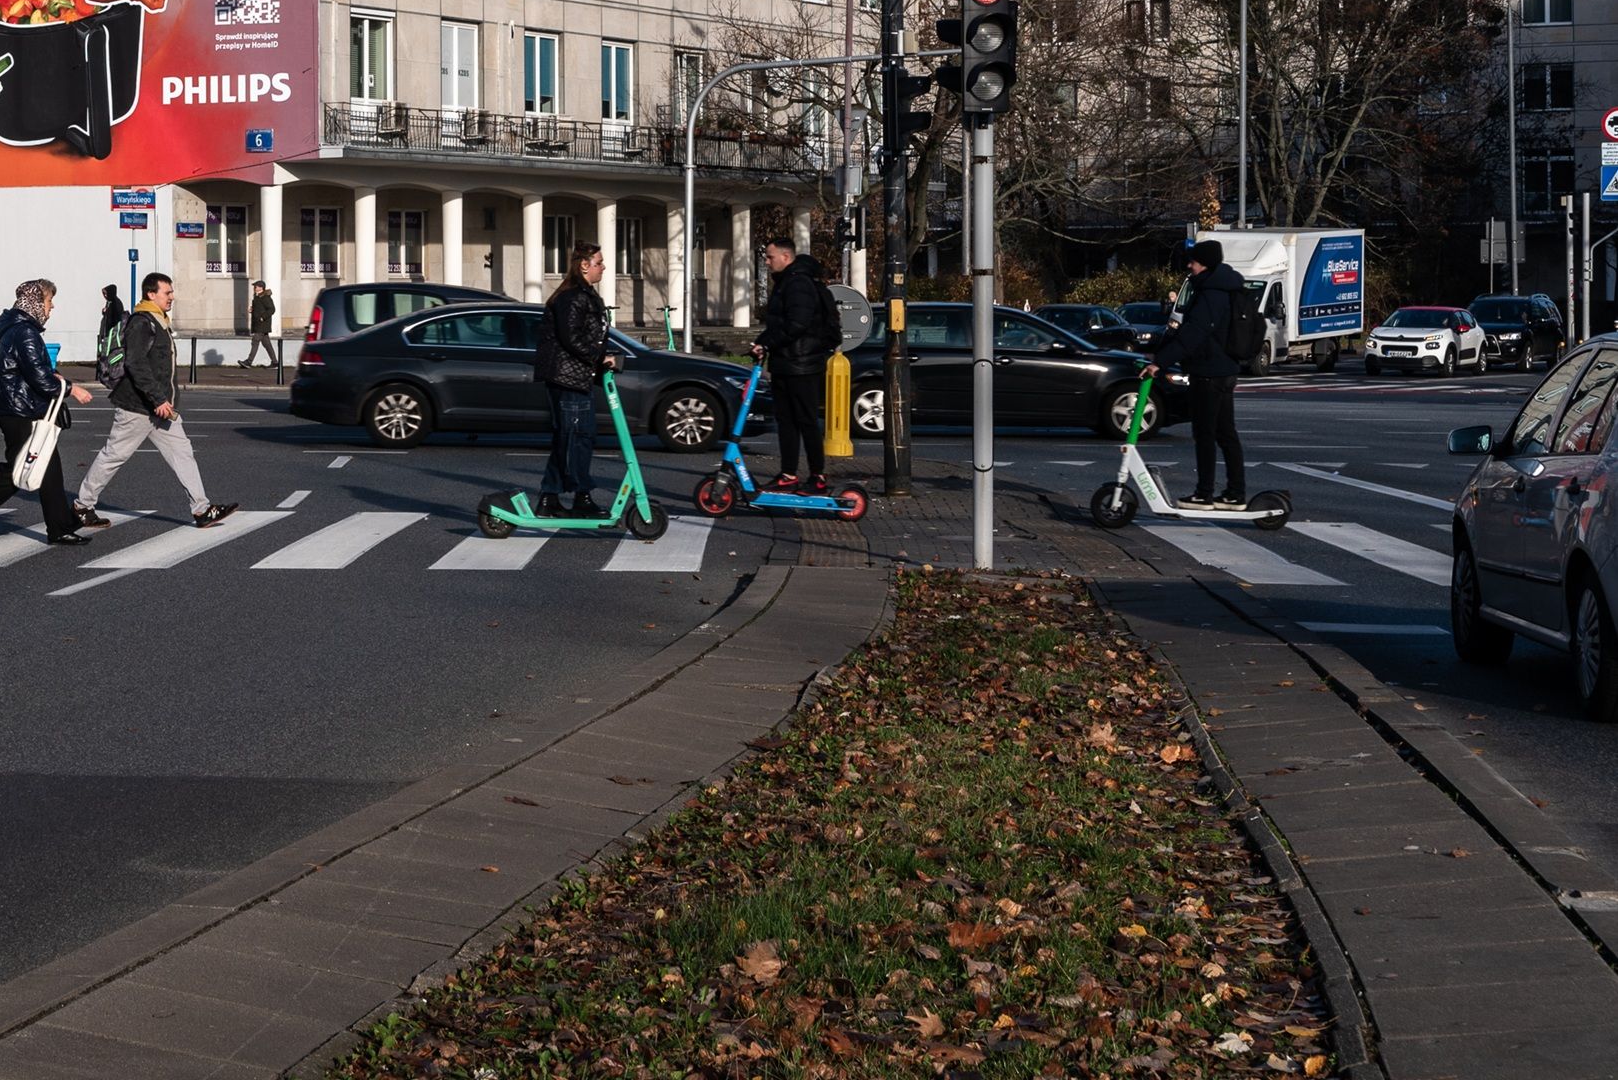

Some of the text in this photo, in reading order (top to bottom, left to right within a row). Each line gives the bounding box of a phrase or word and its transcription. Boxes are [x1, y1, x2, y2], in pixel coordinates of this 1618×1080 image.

[215, 42, 243, 51] przepisy
[162, 73, 292, 105] PHILIPS
[255, 133, 263, 147] 6
[116, 195, 152, 205] Waryńskiego
[1327, 259, 1359, 272] BlueService
